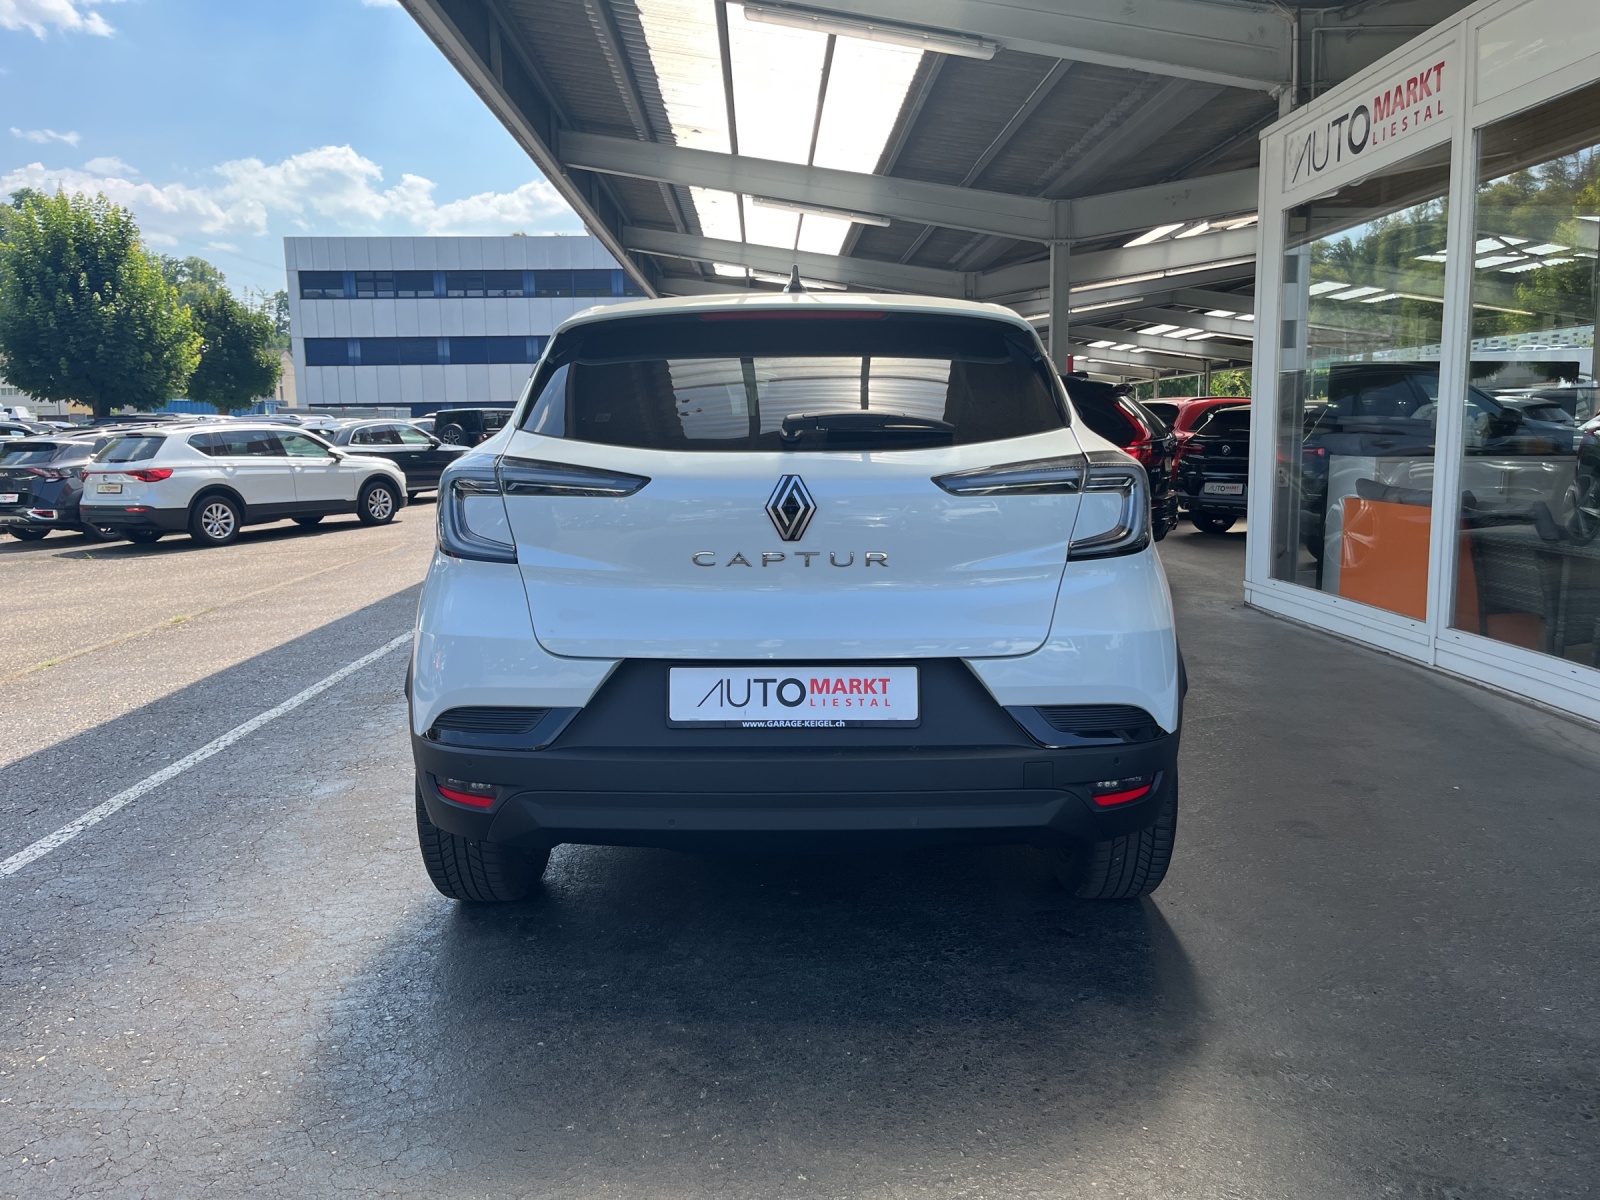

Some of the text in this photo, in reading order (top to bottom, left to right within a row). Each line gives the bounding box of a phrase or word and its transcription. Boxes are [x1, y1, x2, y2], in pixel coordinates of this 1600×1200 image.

[1292, 61, 1445, 183] AUTO MARKT
[1372, 100, 1444, 146] LIESTAL
[692, 550, 889, 568] CAPTUR
[697, 678, 891, 708] AUTO MARKT
[809, 698, 891, 707] LIESTAL
[742, 720, 846, 728] www.GARAGE-KEIGEL.ch
